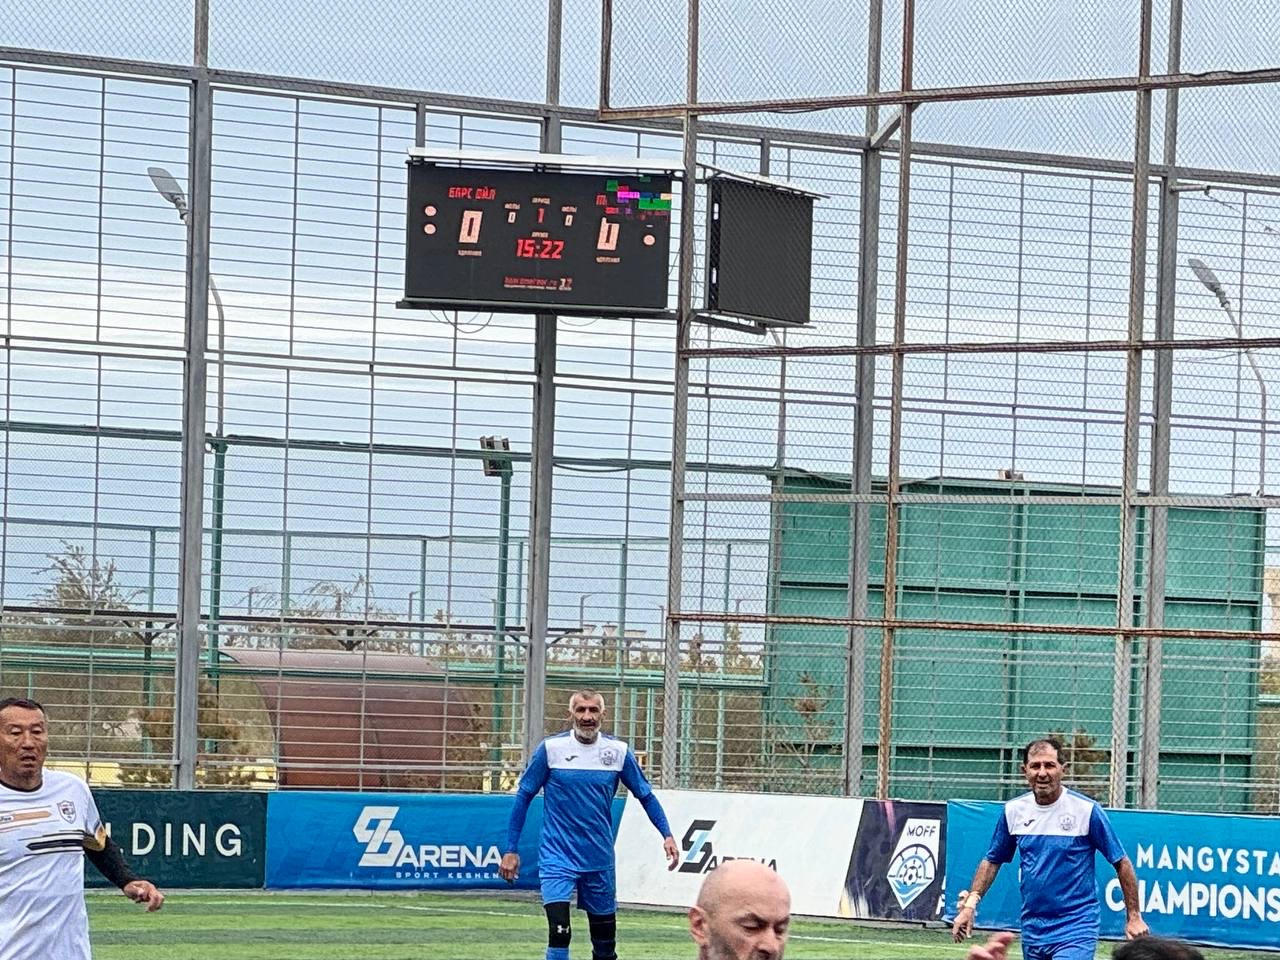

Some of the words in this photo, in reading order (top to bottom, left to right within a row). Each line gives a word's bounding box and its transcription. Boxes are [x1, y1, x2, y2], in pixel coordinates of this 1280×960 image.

[458, 210, 483, 244] 0
[516, 239, 565, 259] 15:22
[906, 825, 937, 838] MOFF
